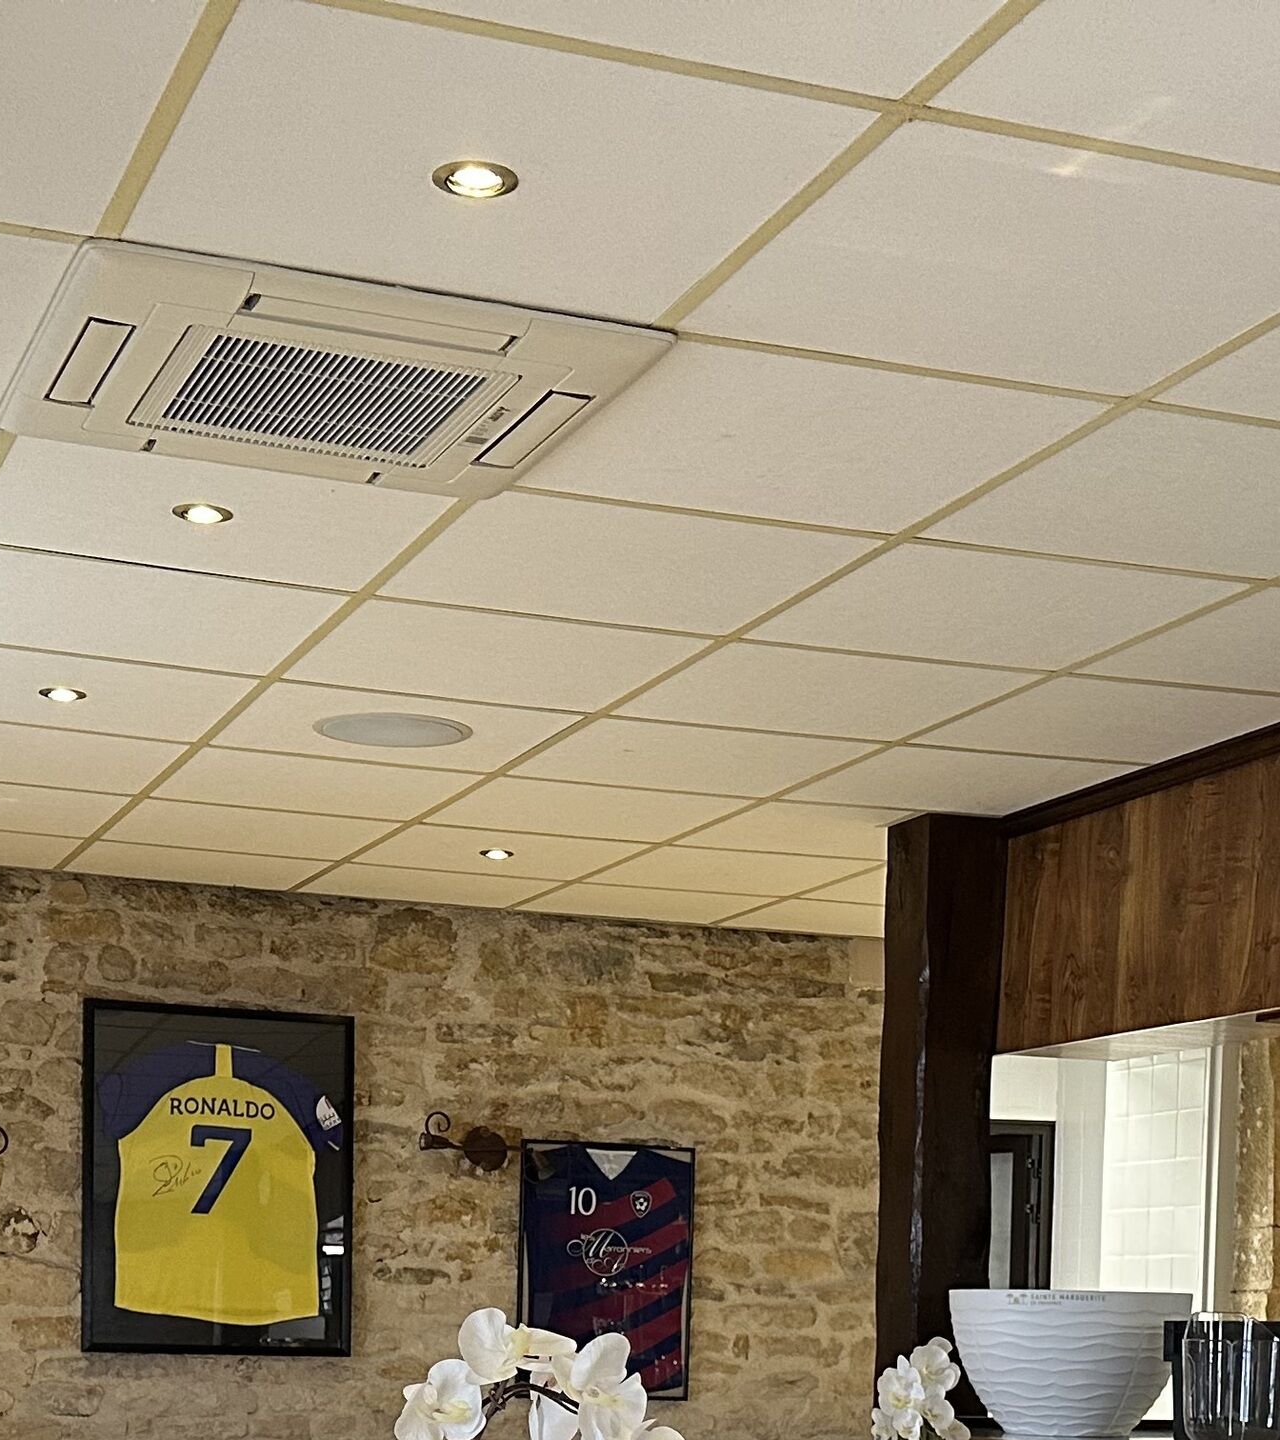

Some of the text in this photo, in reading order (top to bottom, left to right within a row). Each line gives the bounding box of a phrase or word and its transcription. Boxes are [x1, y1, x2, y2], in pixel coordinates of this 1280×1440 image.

[169, 1097, 276, 1121] RONALDO
[190, 1124, 253, 1214] 7
[568, 1186, 598, 1216] 10
